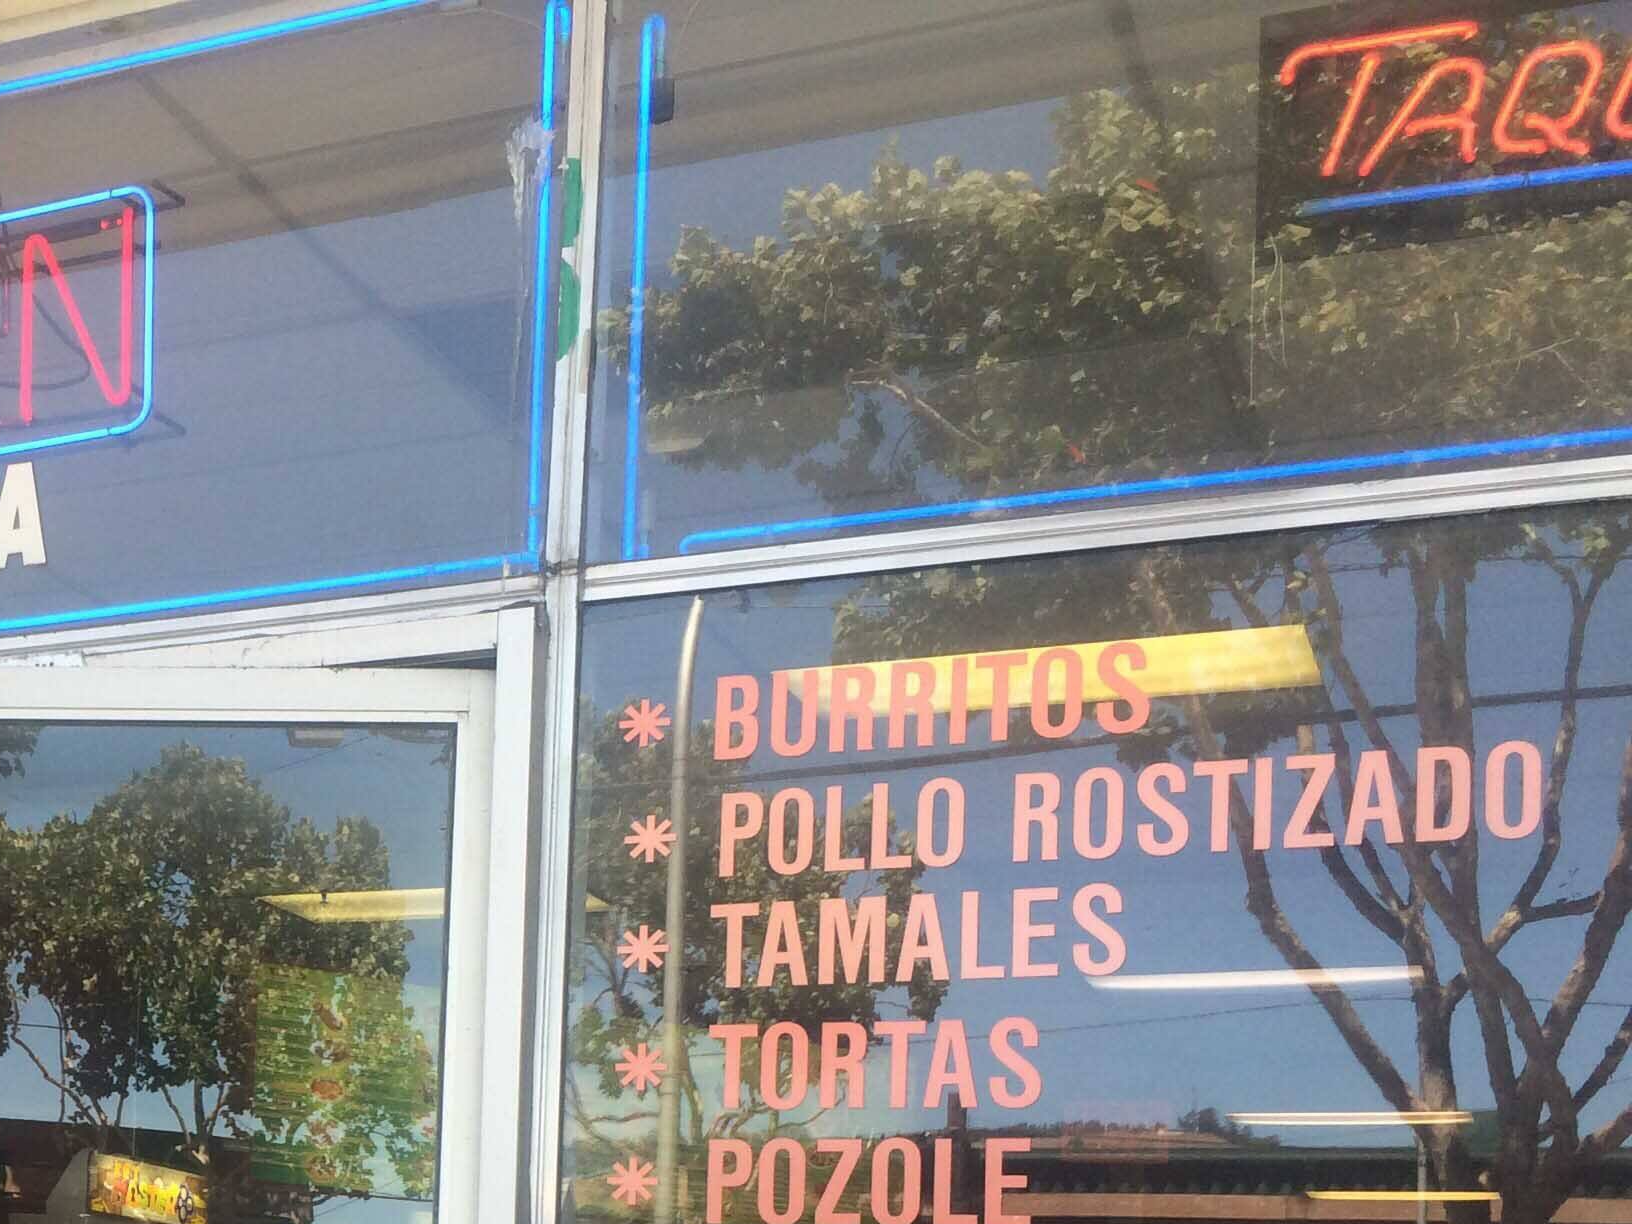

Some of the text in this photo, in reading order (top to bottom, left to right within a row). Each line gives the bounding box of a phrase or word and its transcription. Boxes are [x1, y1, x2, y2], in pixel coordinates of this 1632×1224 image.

[712, 641, 1151, 761] BURRITOS
[718, 740, 1543, 879] POLLO ROSTIZADO
[710, 882, 1128, 989] TAMALES
[709, 1015, 1043, 1111] TORTAS
